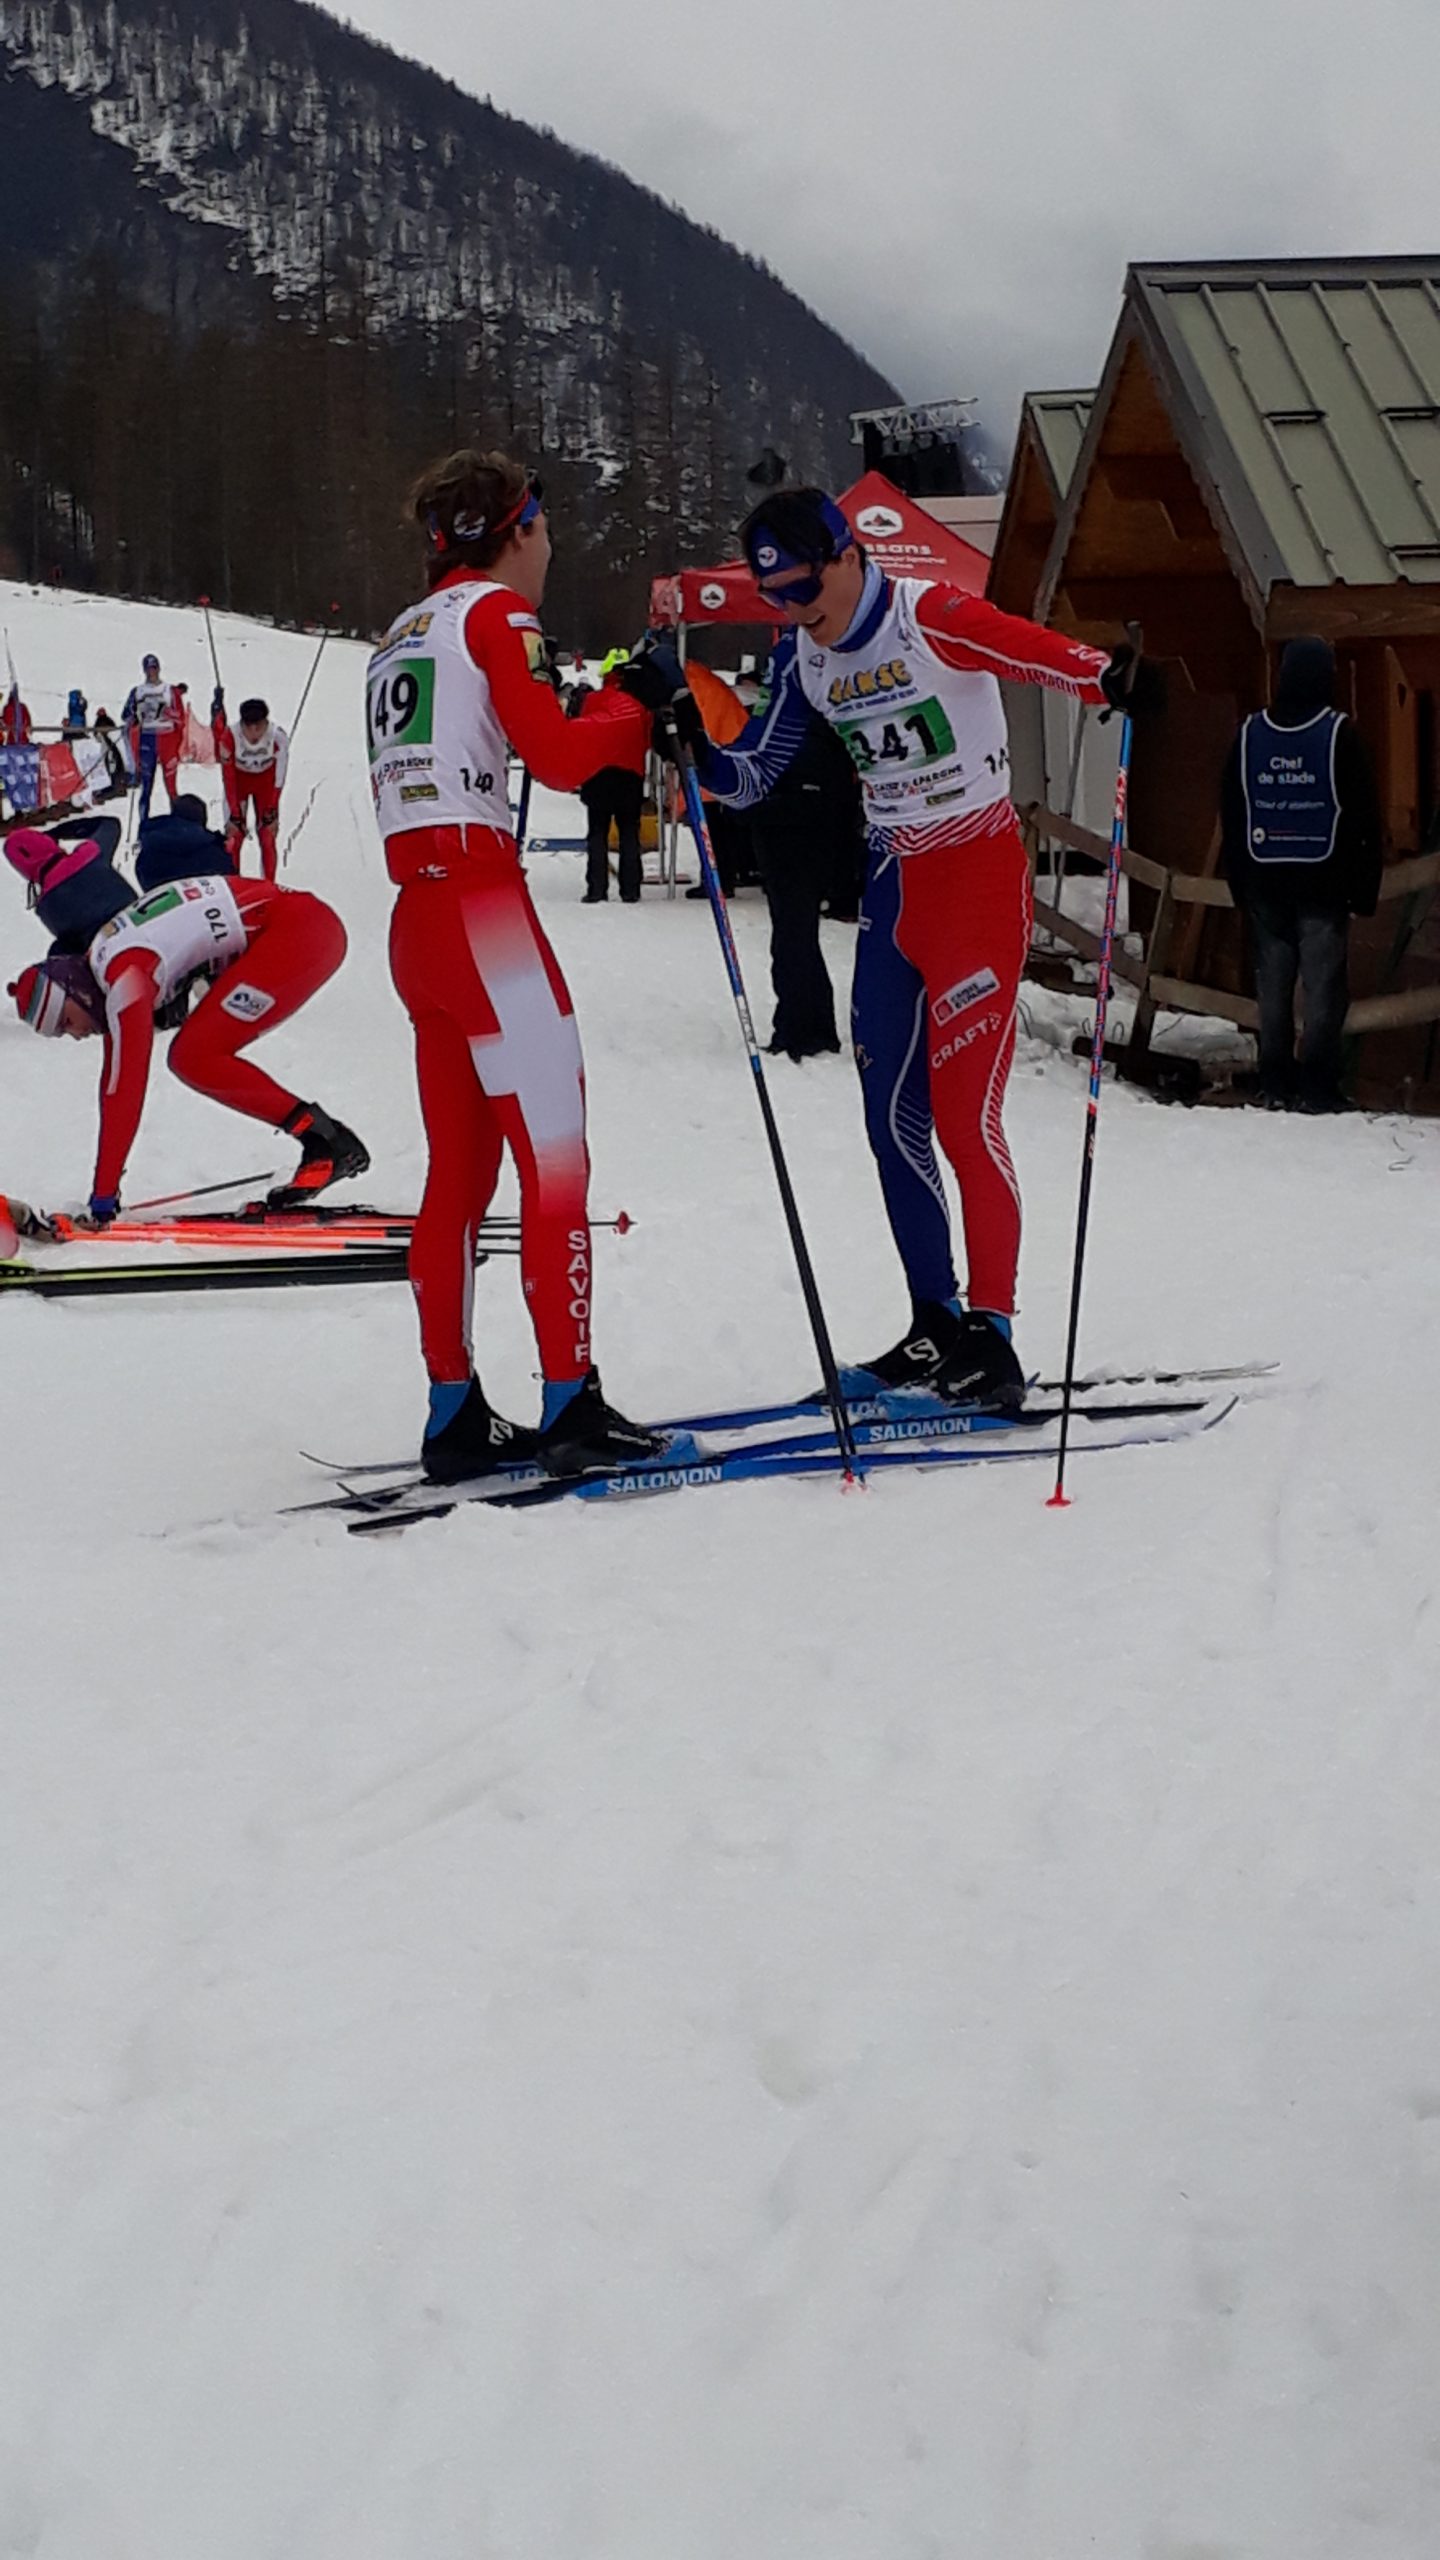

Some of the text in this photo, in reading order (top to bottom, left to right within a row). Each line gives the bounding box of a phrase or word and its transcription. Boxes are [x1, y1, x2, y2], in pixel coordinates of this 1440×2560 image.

[1270, 756, 1303, 770] Chef
[1257, 771, 1316, 784] de stade
[204, 907, 229, 944] 170
[931, 1018, 989, 1069] CRAFT
[868, 1416, 972, 1443] SALOMON
[606, 1466, 722, 1496] SALOMON
